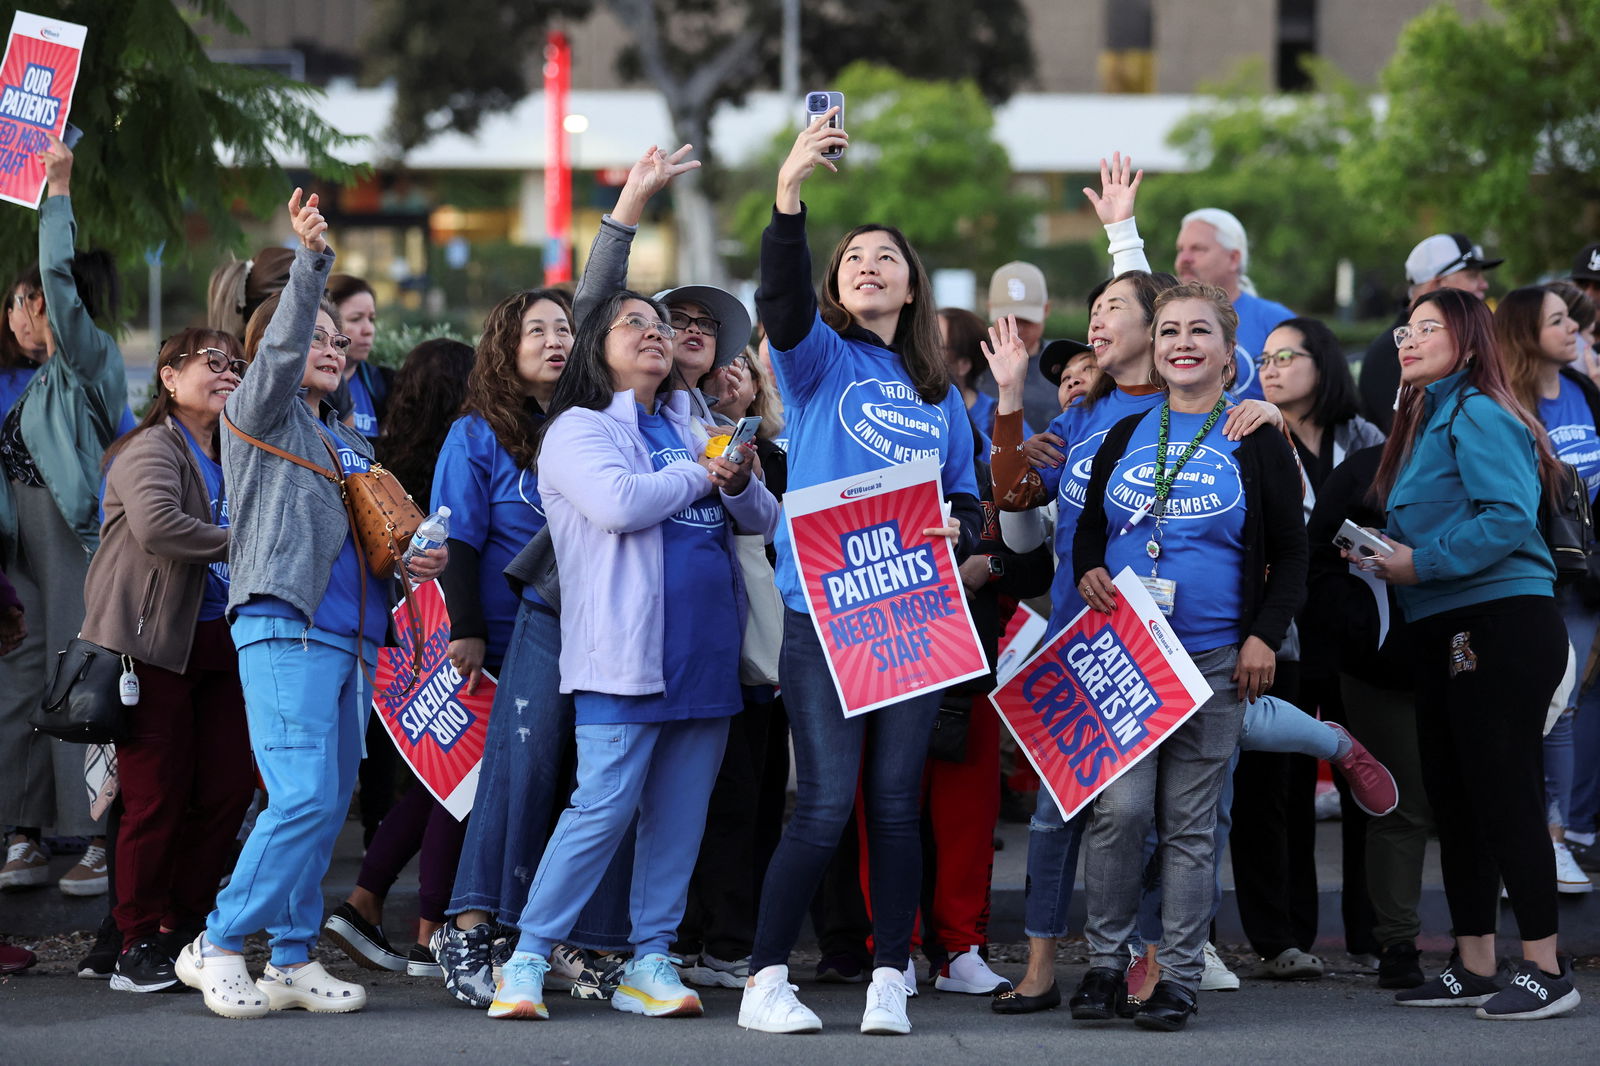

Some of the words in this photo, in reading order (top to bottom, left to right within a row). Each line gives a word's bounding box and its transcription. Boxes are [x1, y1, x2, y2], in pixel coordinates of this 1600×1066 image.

[23, 66, 52, 97] OUR
[0, 88, 59, 126] PATIENTS
[0, 119, 18, 146] ED
[0, 147, 29, 176] TAFF
[930, 425, 940, 439] 30
[1203, 401, 1225, 431] ALASKA
[854, 418, 892, 455] UNION
[1166, 445, 1206, 459] ROD
[1177, 438, 1201, 466] ALASKA
[1177, 471, 1200, 482] ocal
[1201, 474, 1216, 485] 30
[846, 526, 899, 567] OUR
[827, 549, 933, 609] PATIENTS
[828, 607, 889, 650] NEED
[889, 585, 957, 631] MORE
[871, 626, 932, 673] STAFF
[1066, 642, 1113, 700] CARE
[1090, 631, 1157, 716] PATIENT
[401, 658, 463, 740] PATIENTS
[1098, 690, 1127, 720] IS
[428, 700, 469, 745] OUR
[1022, 661, 1119, 787] CRISIS
[1111, 712, 1142, 746] IN
